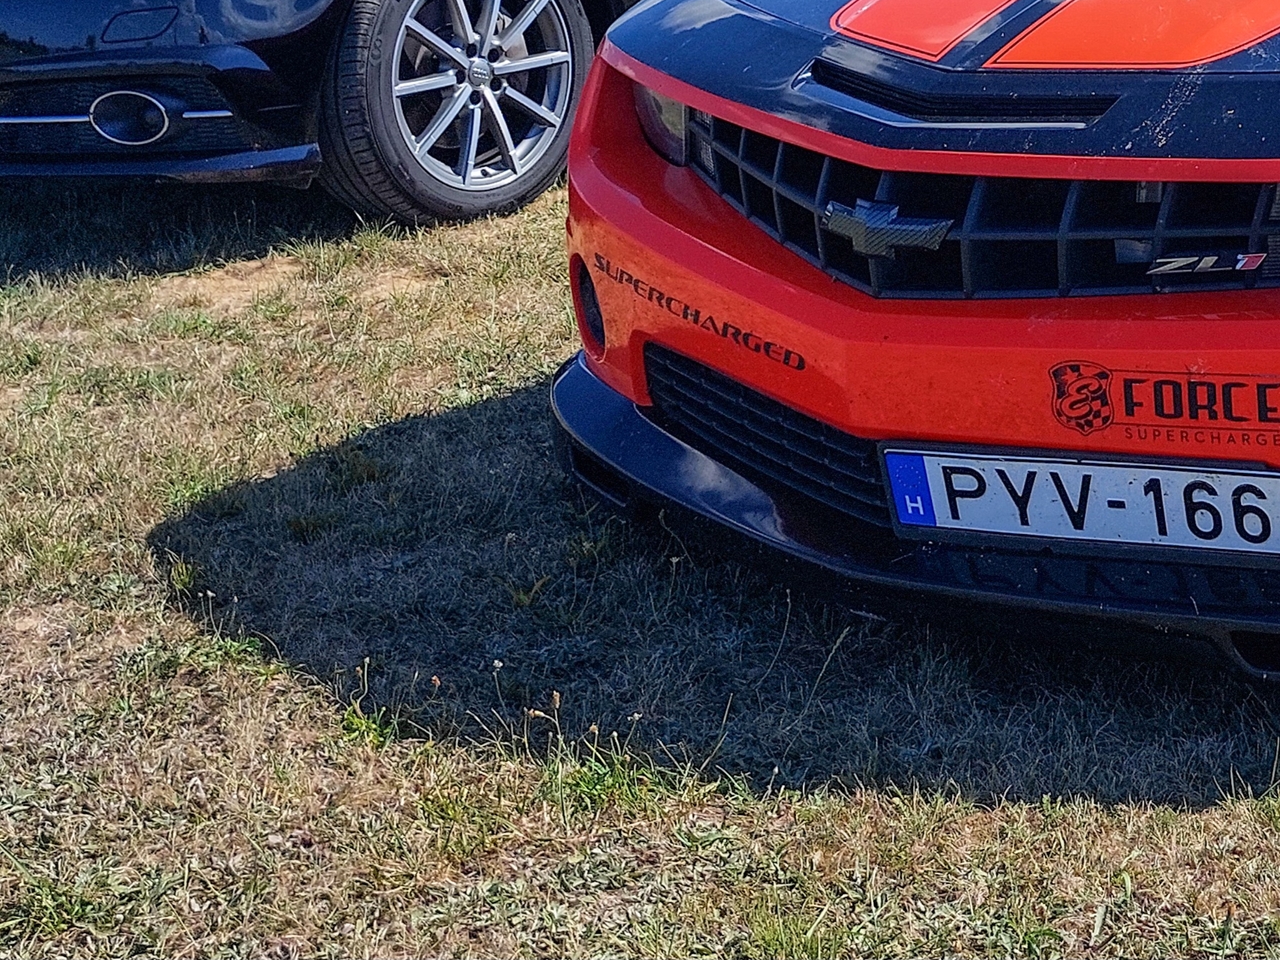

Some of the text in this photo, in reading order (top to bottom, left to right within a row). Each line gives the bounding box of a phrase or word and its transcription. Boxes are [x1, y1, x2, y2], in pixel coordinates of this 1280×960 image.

[1146, 253, 1267, 275] ZL1
[594, 253, 806, 371] SUPERCHARGED
[905, 494, 925, 516] H
[941, 465, 1273, 544] PYV-166
